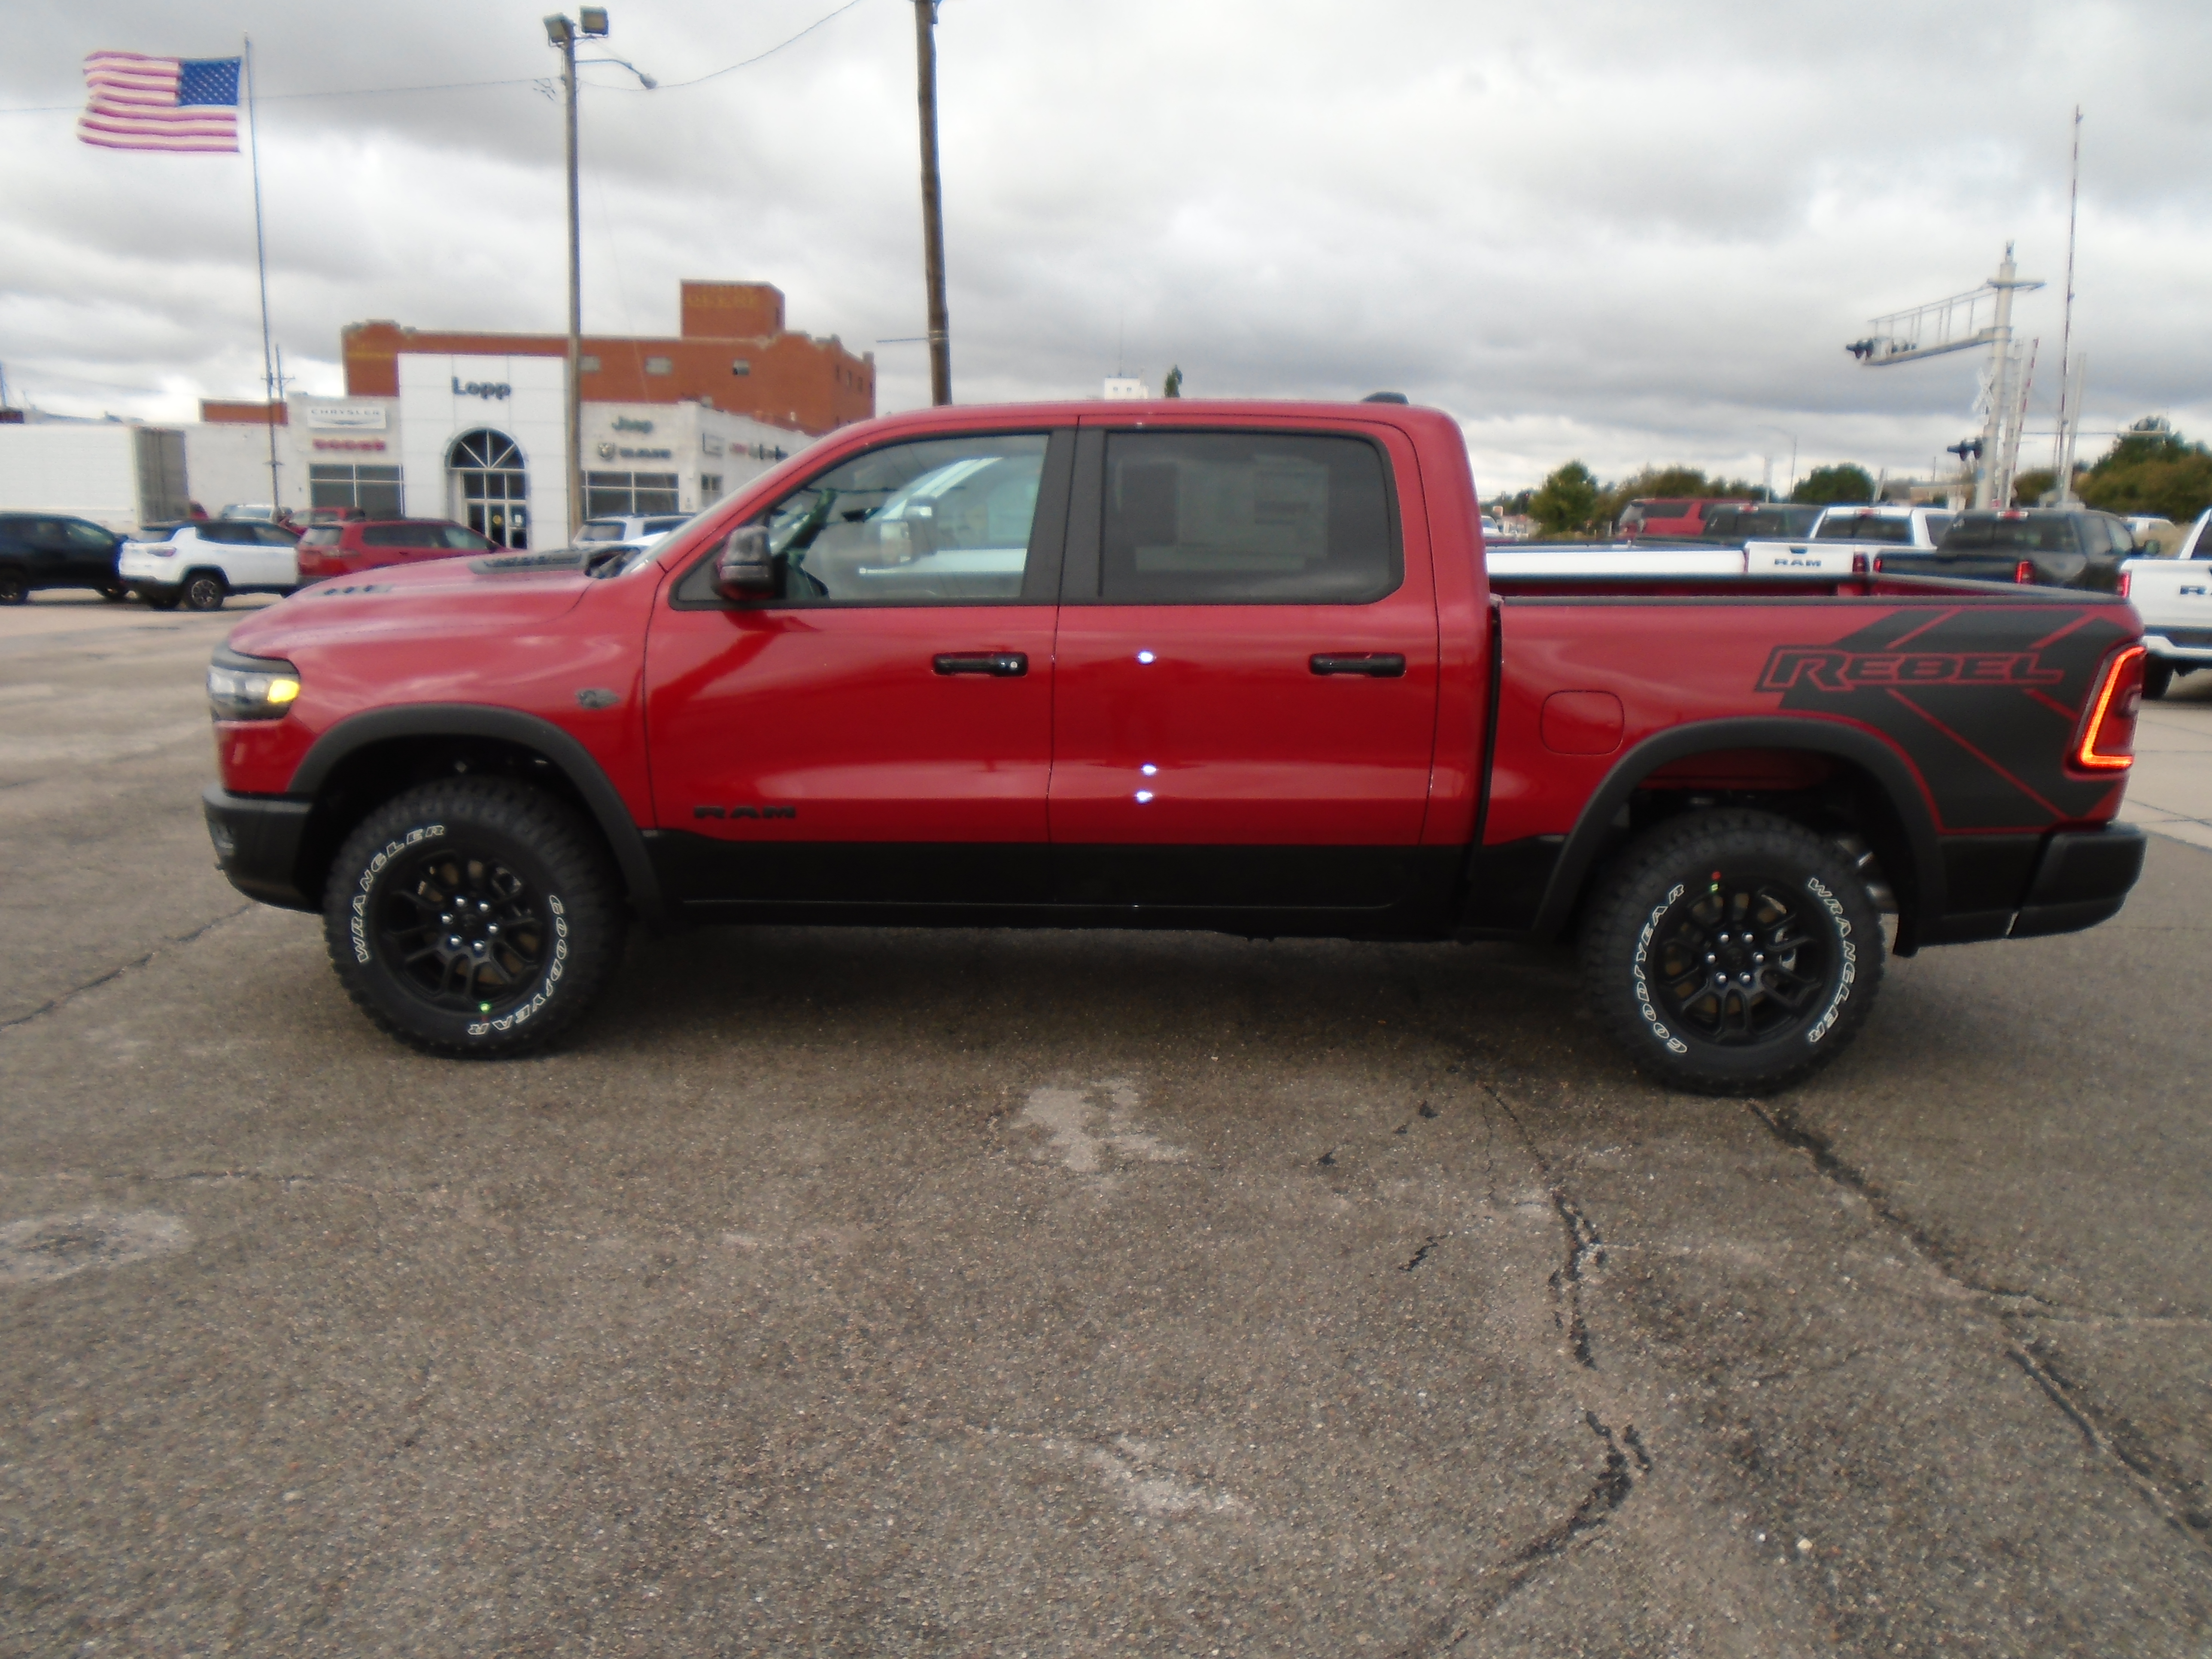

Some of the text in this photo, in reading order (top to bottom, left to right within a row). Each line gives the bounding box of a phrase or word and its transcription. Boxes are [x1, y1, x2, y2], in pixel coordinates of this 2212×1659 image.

[452, 377, 511, 400] Lopp
[1774, 559, 1822, 567] RAM
[2180, 585, 2212, 596] R
[1755, 646, 2064, 692] REBEL
[693, 805, 796, 819] RAM
[351, 824, 445, 963] WRANGLER
[468, 895, 568, 1035] GOODYEAR
[1634, 884, 1688, 1054] GOODYEAR
[1808, 877, 1856, 1043] WRANGLER
